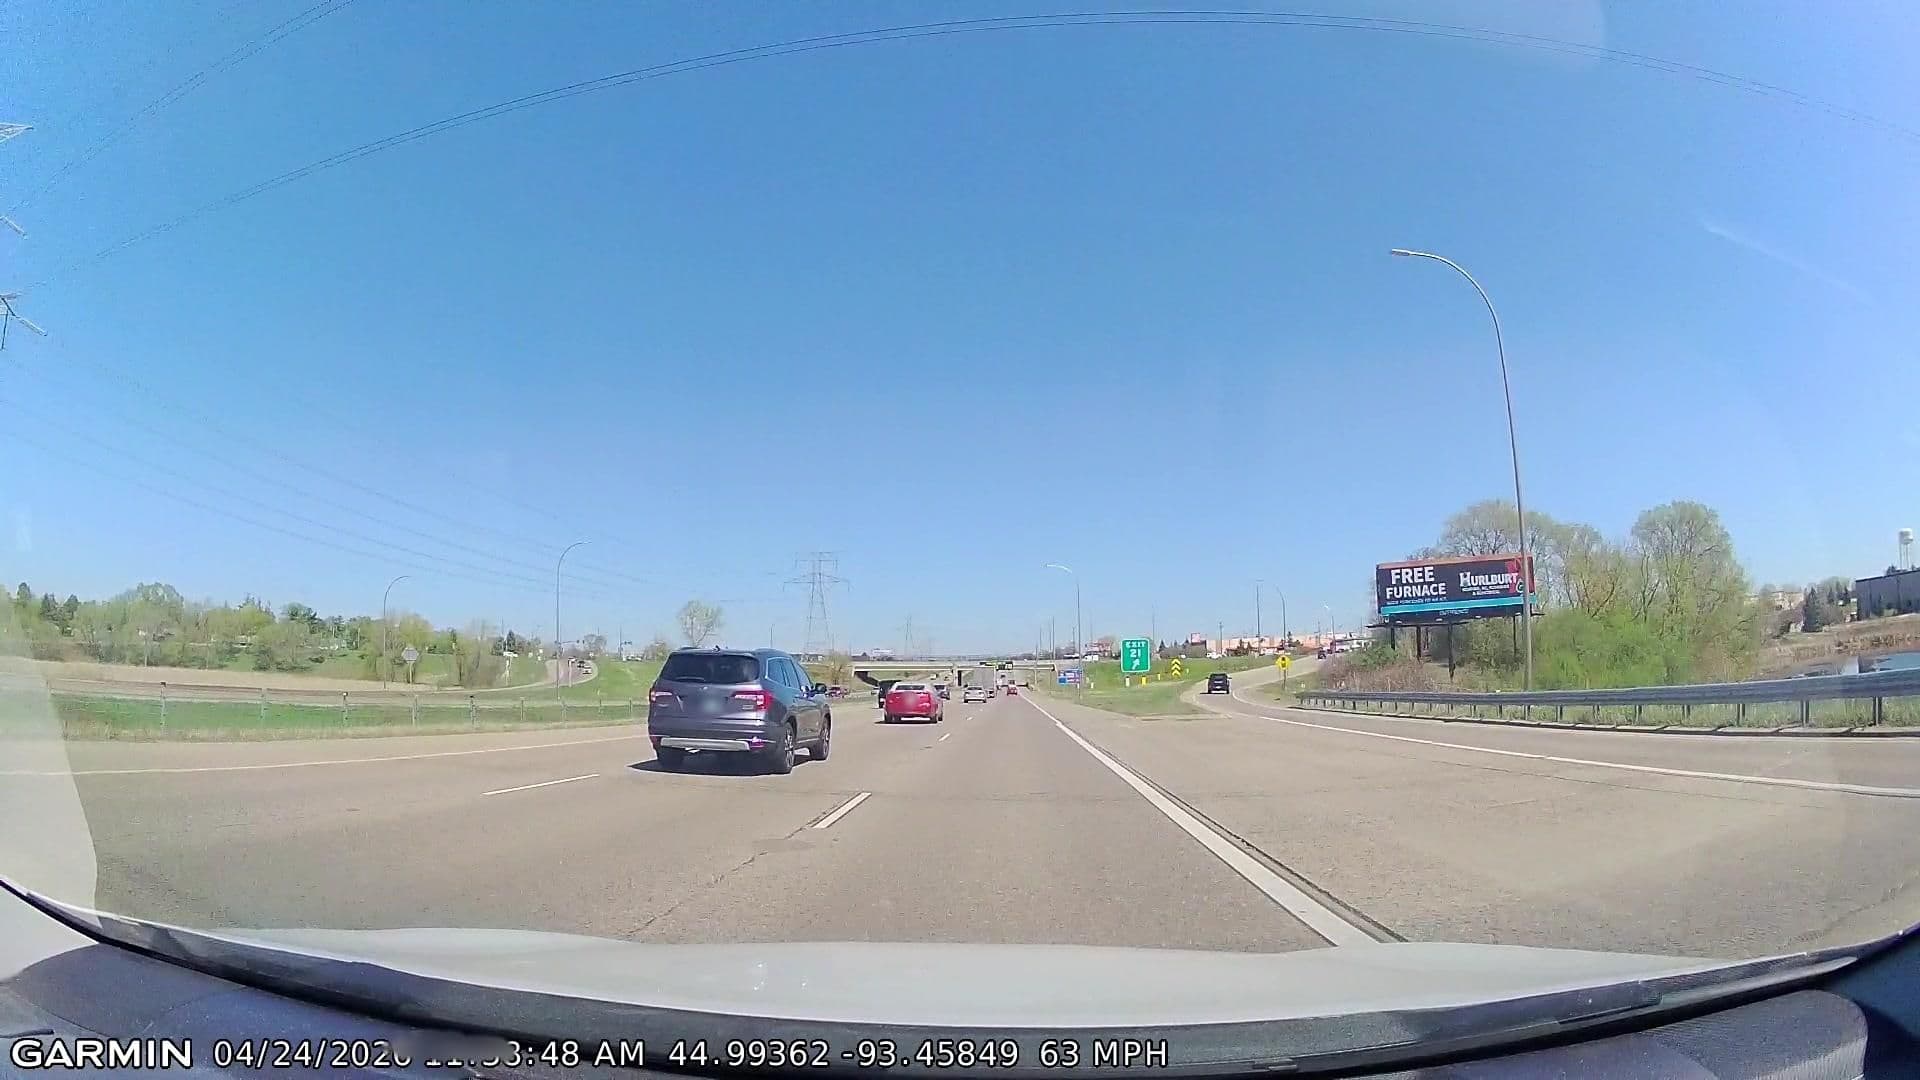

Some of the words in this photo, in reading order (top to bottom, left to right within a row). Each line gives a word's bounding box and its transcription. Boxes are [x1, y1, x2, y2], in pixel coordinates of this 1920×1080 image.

[1391, 566, 1435, 584] FREE
[1459, 571, 1519, 587] HURLBURT
[1385, 582, 1447, 600] FURNACE
[1129, 649, 1141, 658] 21
